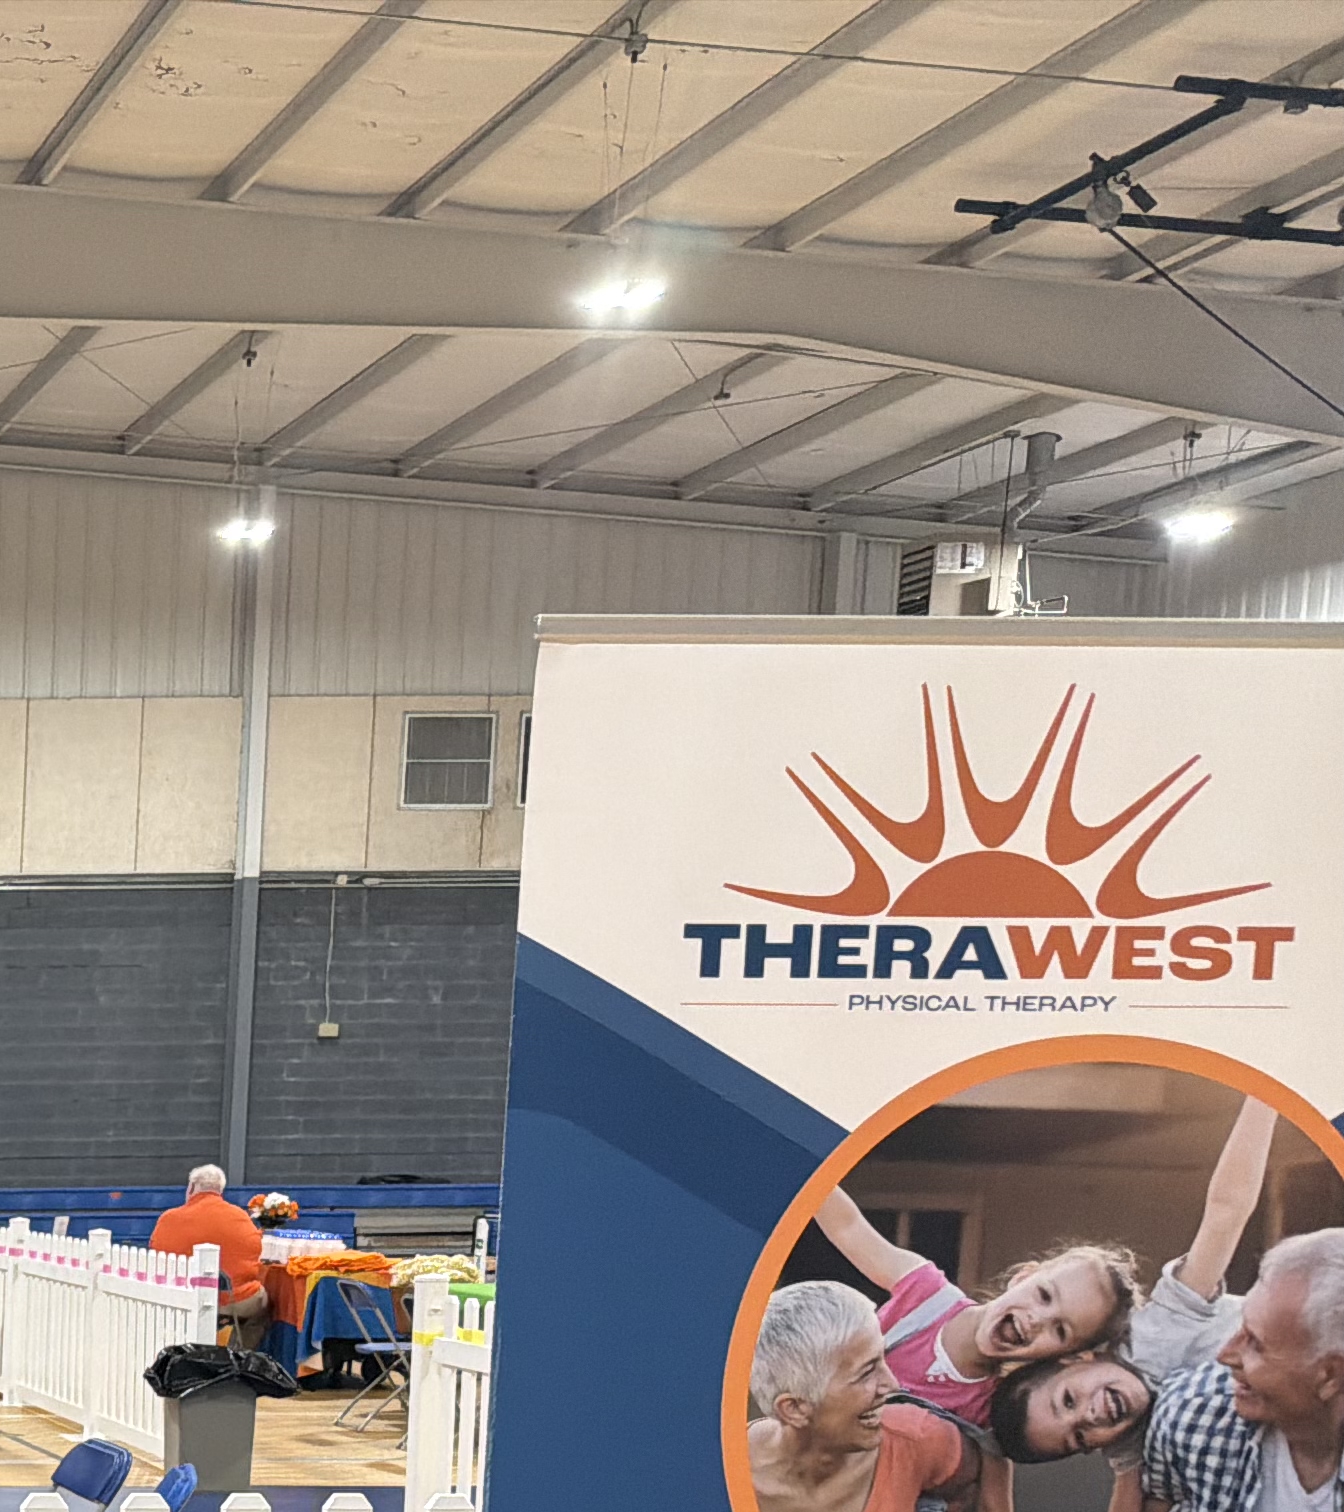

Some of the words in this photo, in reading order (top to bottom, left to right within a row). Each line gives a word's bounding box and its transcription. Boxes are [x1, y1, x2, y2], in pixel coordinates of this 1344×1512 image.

[683, 923, 1296, 981] THERAWEST
[847, 994, 977, 1013] PHYSICAL
[984, 994, 1118, 1014] THERAPY
